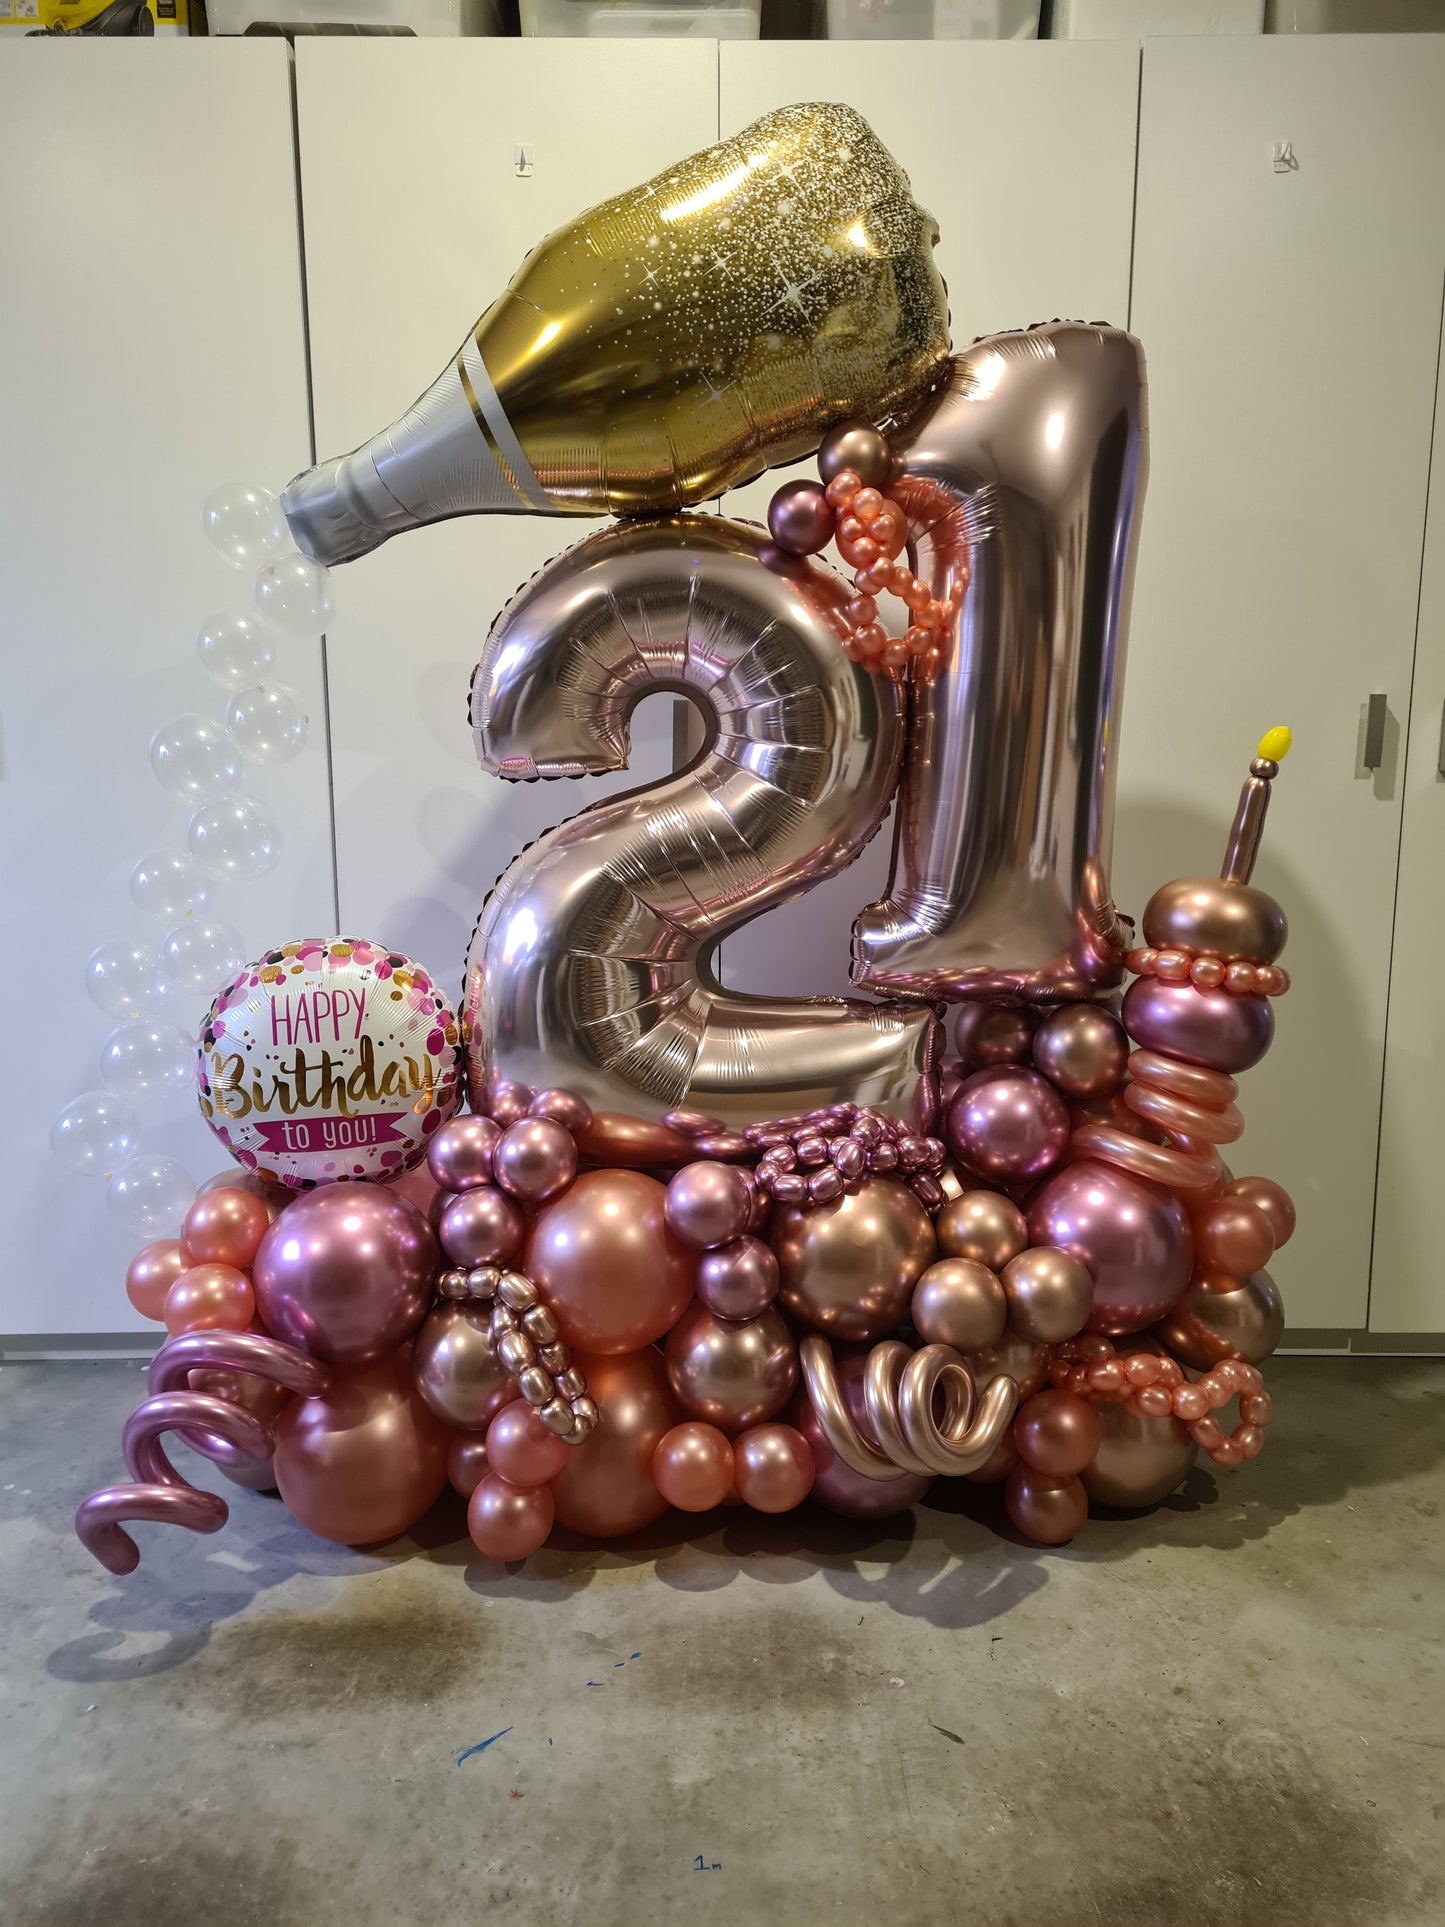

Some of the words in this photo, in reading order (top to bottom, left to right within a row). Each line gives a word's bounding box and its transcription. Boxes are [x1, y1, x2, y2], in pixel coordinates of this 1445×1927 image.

[464, 320, 1149, 1128] 21
[270, 987, 366, 1046] HAPPY
[210, 1034, 442, 1119] Birthday
[281, 1121, 310, 1151] to
[322, 1116, 377, 1146] you!
